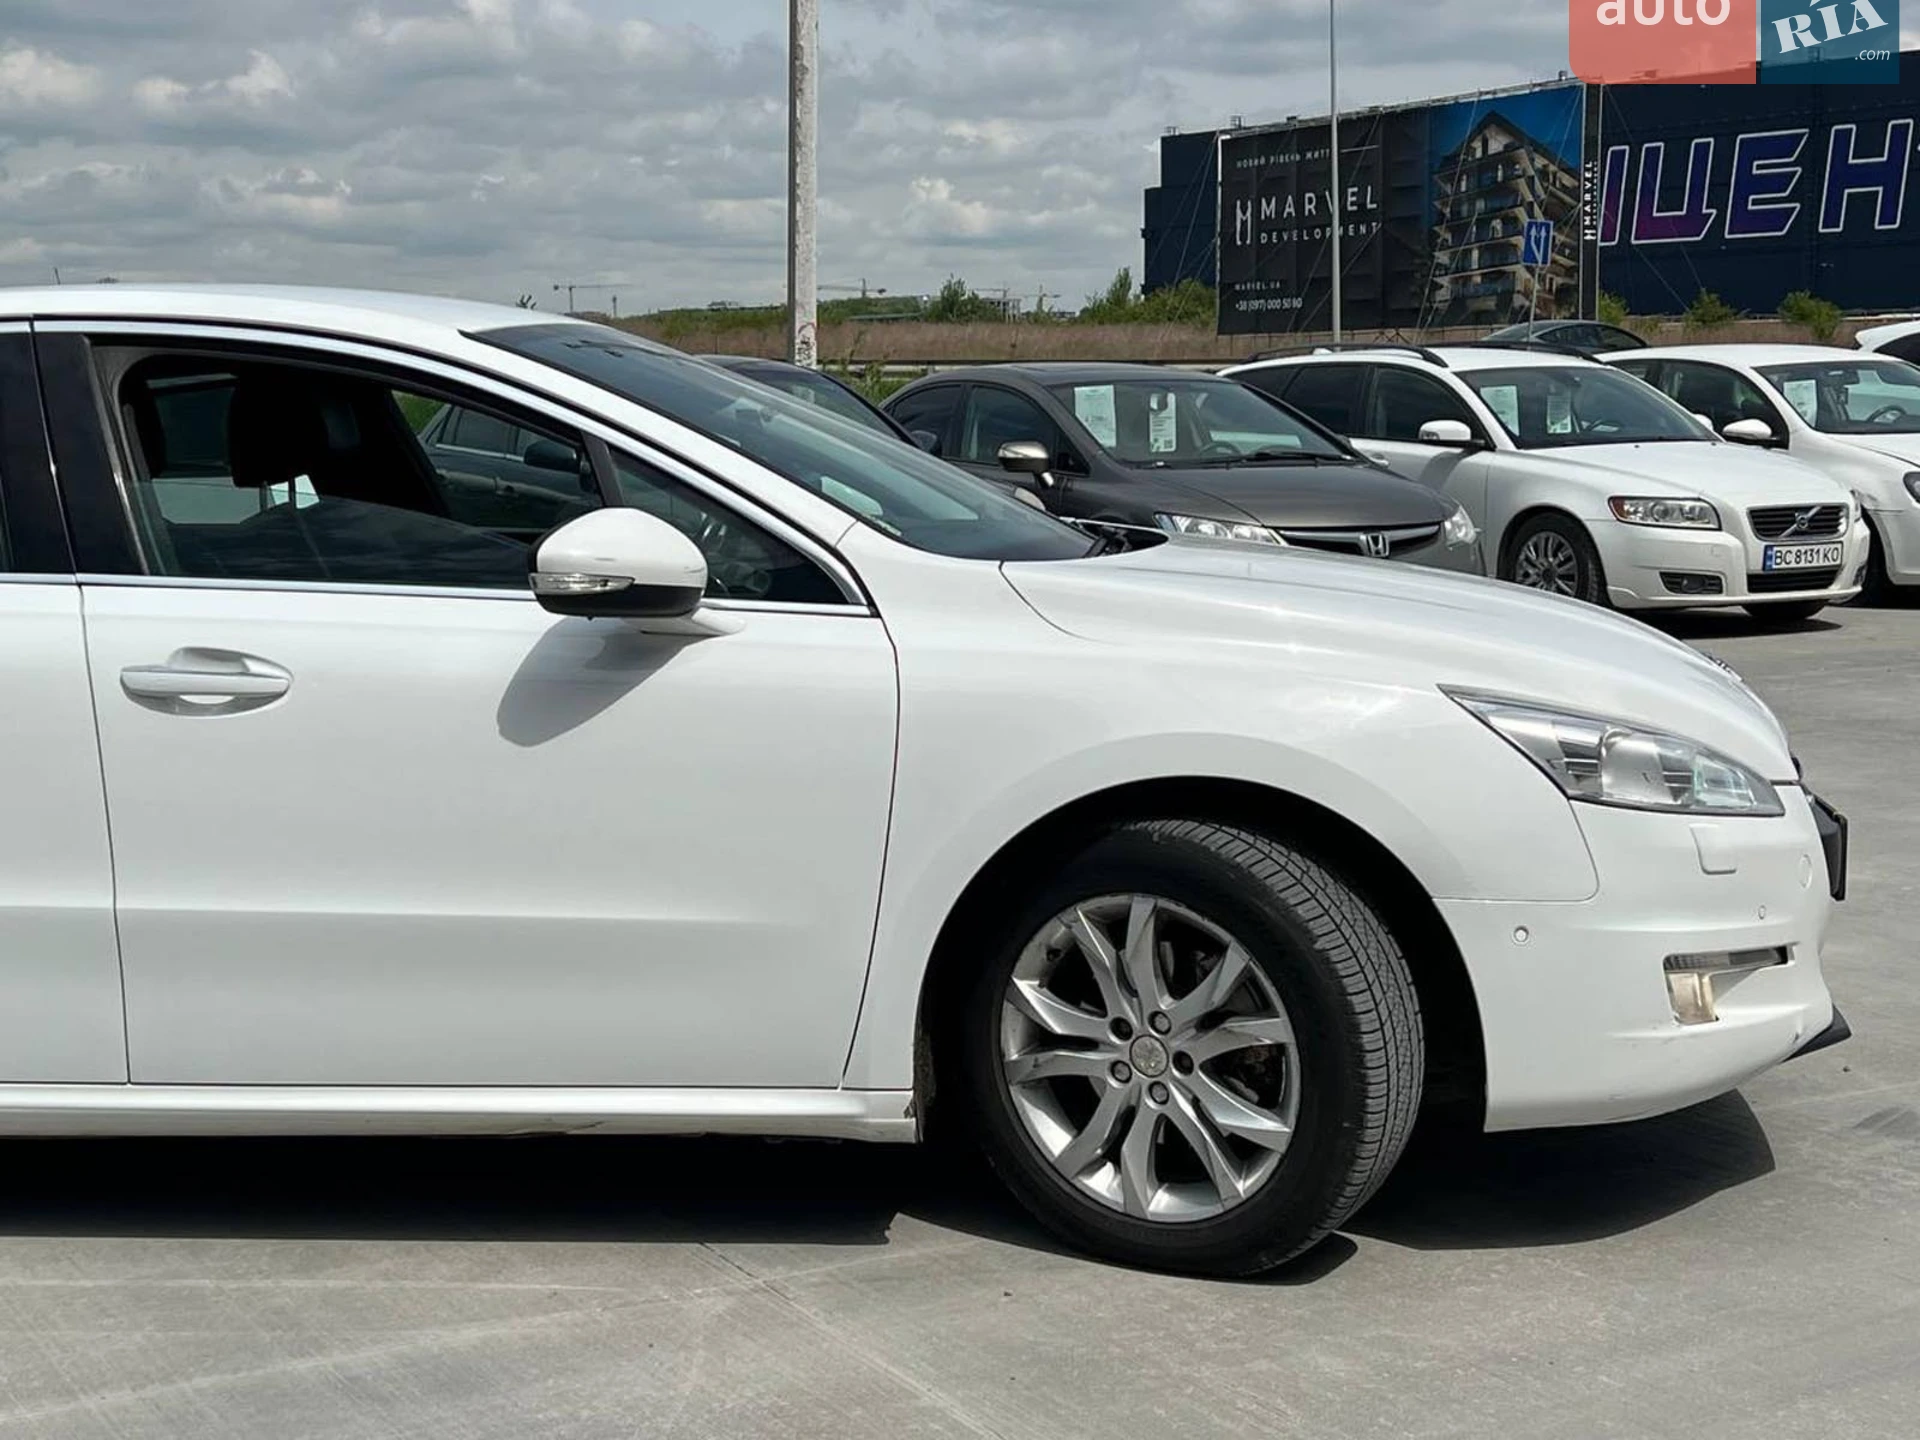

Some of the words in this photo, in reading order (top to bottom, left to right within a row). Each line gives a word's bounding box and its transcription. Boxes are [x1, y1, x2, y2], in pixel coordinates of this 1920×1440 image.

[1305, 148, 1331, 160] ЖИТТ
[1584, 161, 1593, 226] MARVEL
[1598, 118, 1920, 246] ІЦЕН
[1774, 549, 1793, 566] BC
[1795, 548, 1821, 565] 8131
[1823, 546, 1840, 563] KO
